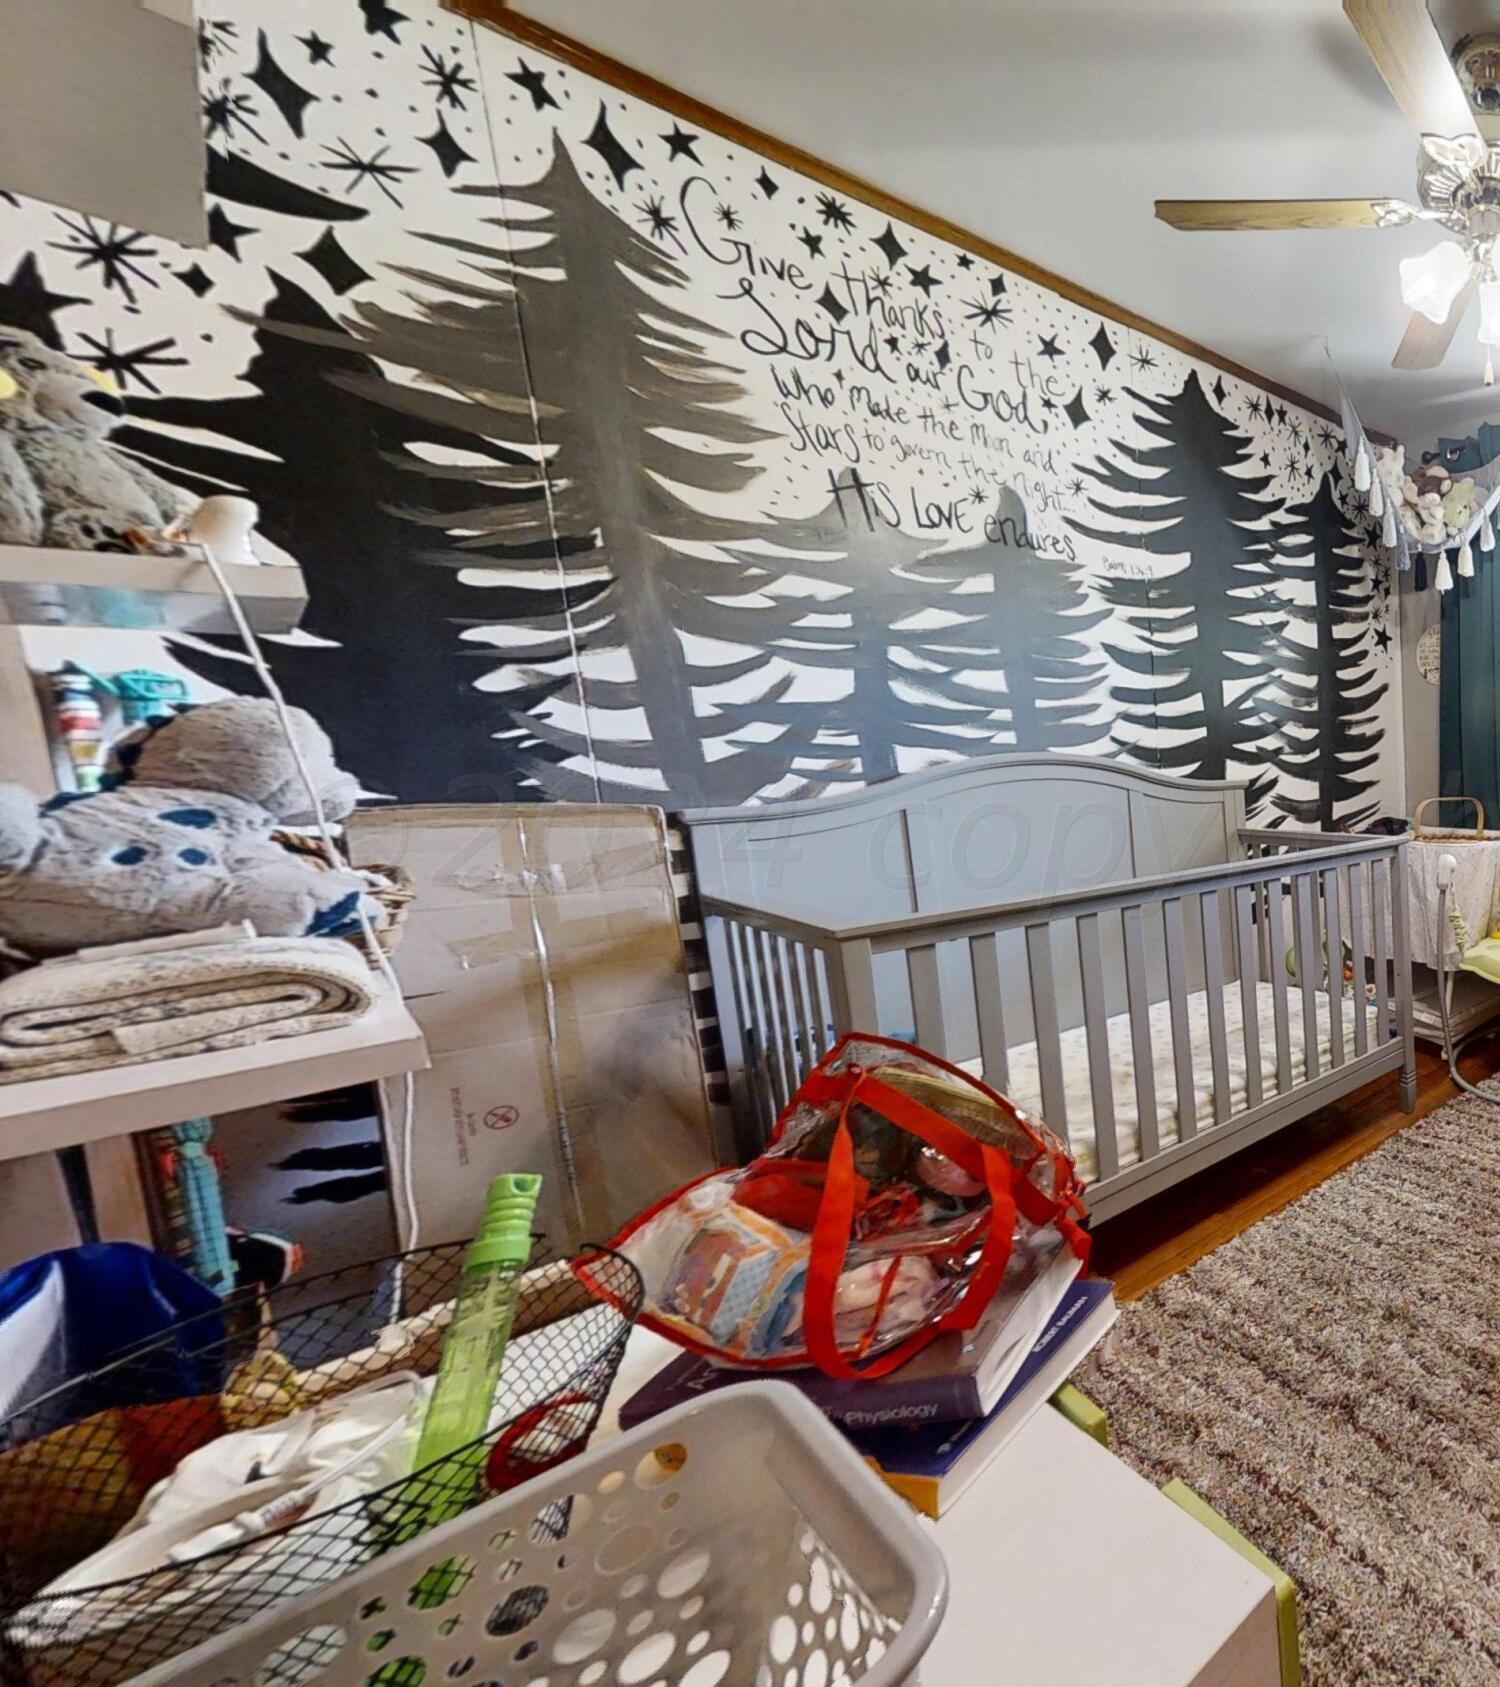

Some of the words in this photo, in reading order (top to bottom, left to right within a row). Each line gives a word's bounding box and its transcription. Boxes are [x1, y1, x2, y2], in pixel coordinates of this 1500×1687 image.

[680, 176, 814, 290] Give
[830, 261, 944, 339] thanks
[969, 329, 993, 362] to
[1008, 351, 1066, 397] the
[716, 277, 896, 384] Lord
[907, 362, 946, 391] our
[849, 385, 911, 424] made
[917, 406, 965, 441] the
[1023, 449, 1059, 476] and
[862, 427, 885, 451] to
[958, 452, 1006, 486] the
[984, 514, 1076, 561] endures
[844, 1403, 940, 1425] Physiology
